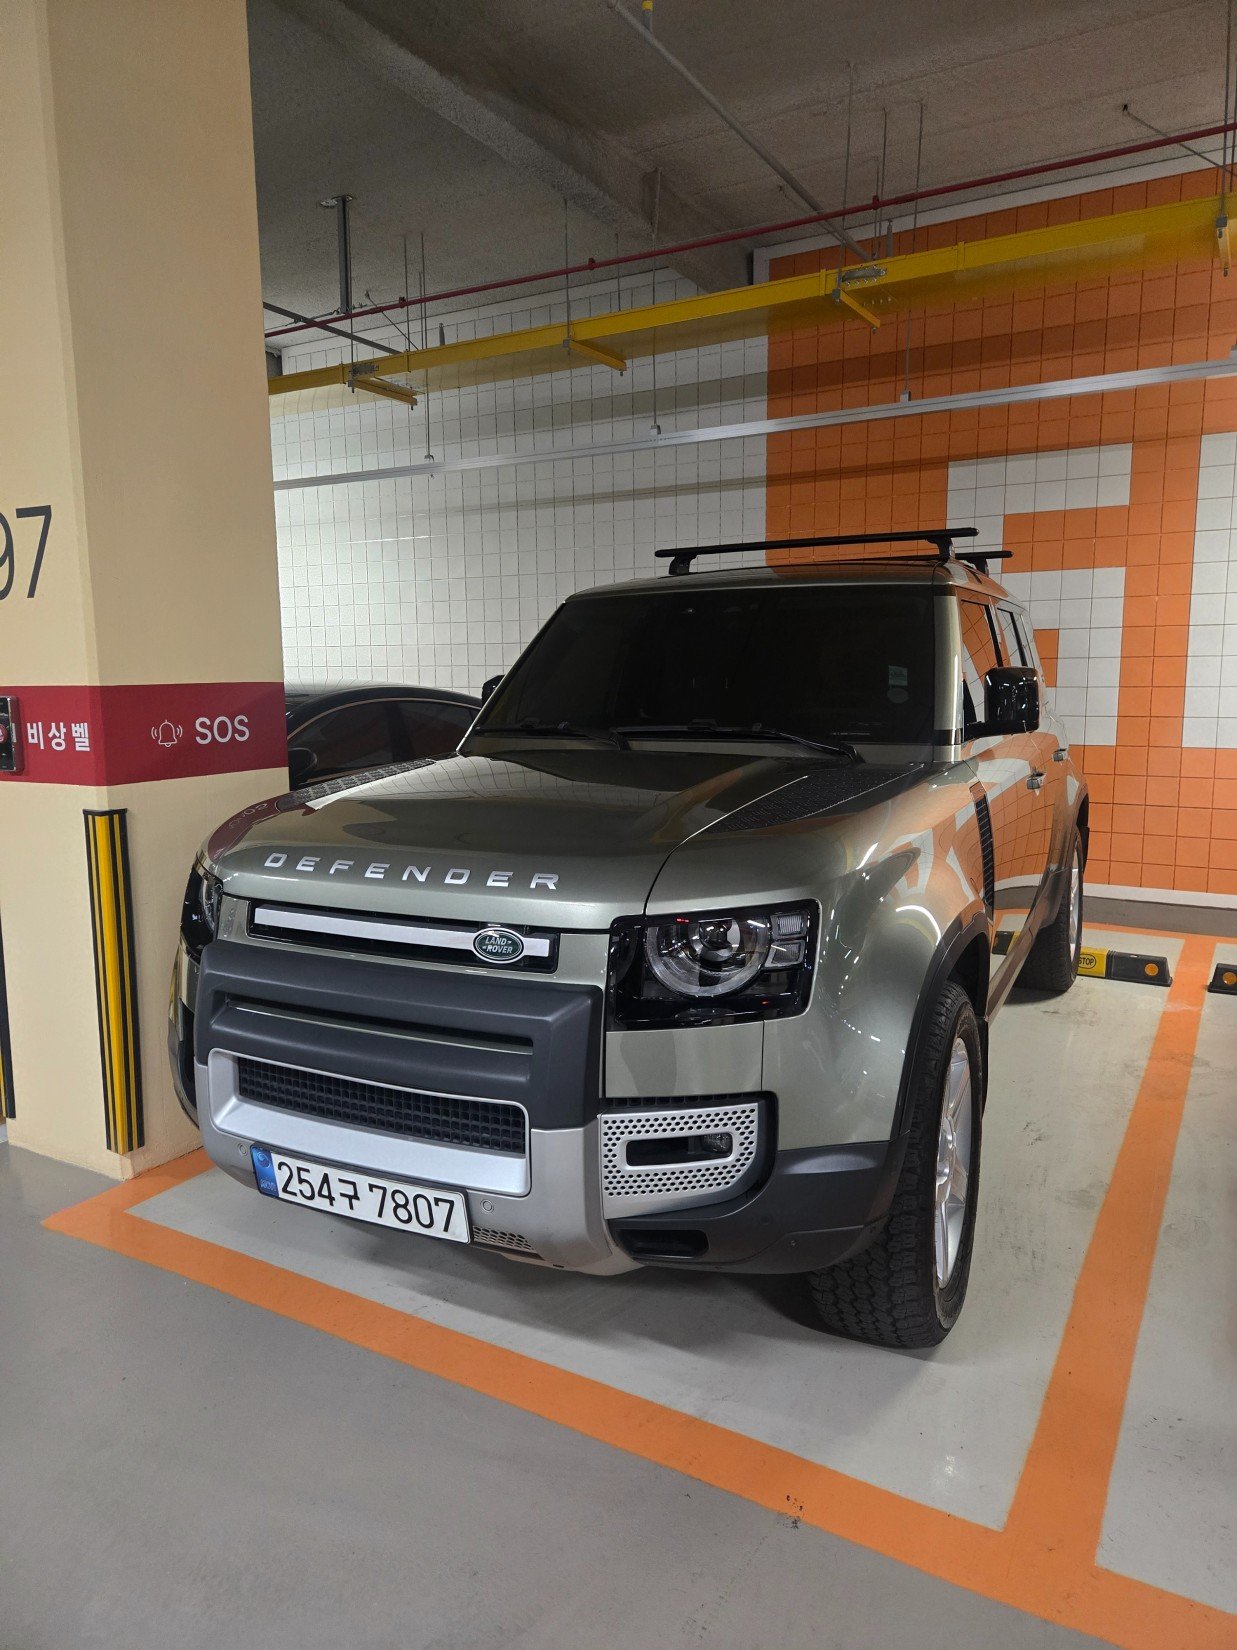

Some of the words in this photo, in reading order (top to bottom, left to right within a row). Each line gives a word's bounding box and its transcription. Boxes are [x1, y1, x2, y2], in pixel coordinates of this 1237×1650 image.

[26, 722, 90, 752] 비상벨
[195, 715, 250, 745] SOS
[264, 852, 560, 890] DEFENDER
[485, 937, 507, 945] LAND
[486, 944, 513, 953] ROVER
[277, 1161, 360, 1211] 254구
[368, 1182, 455, 1233] 7807
